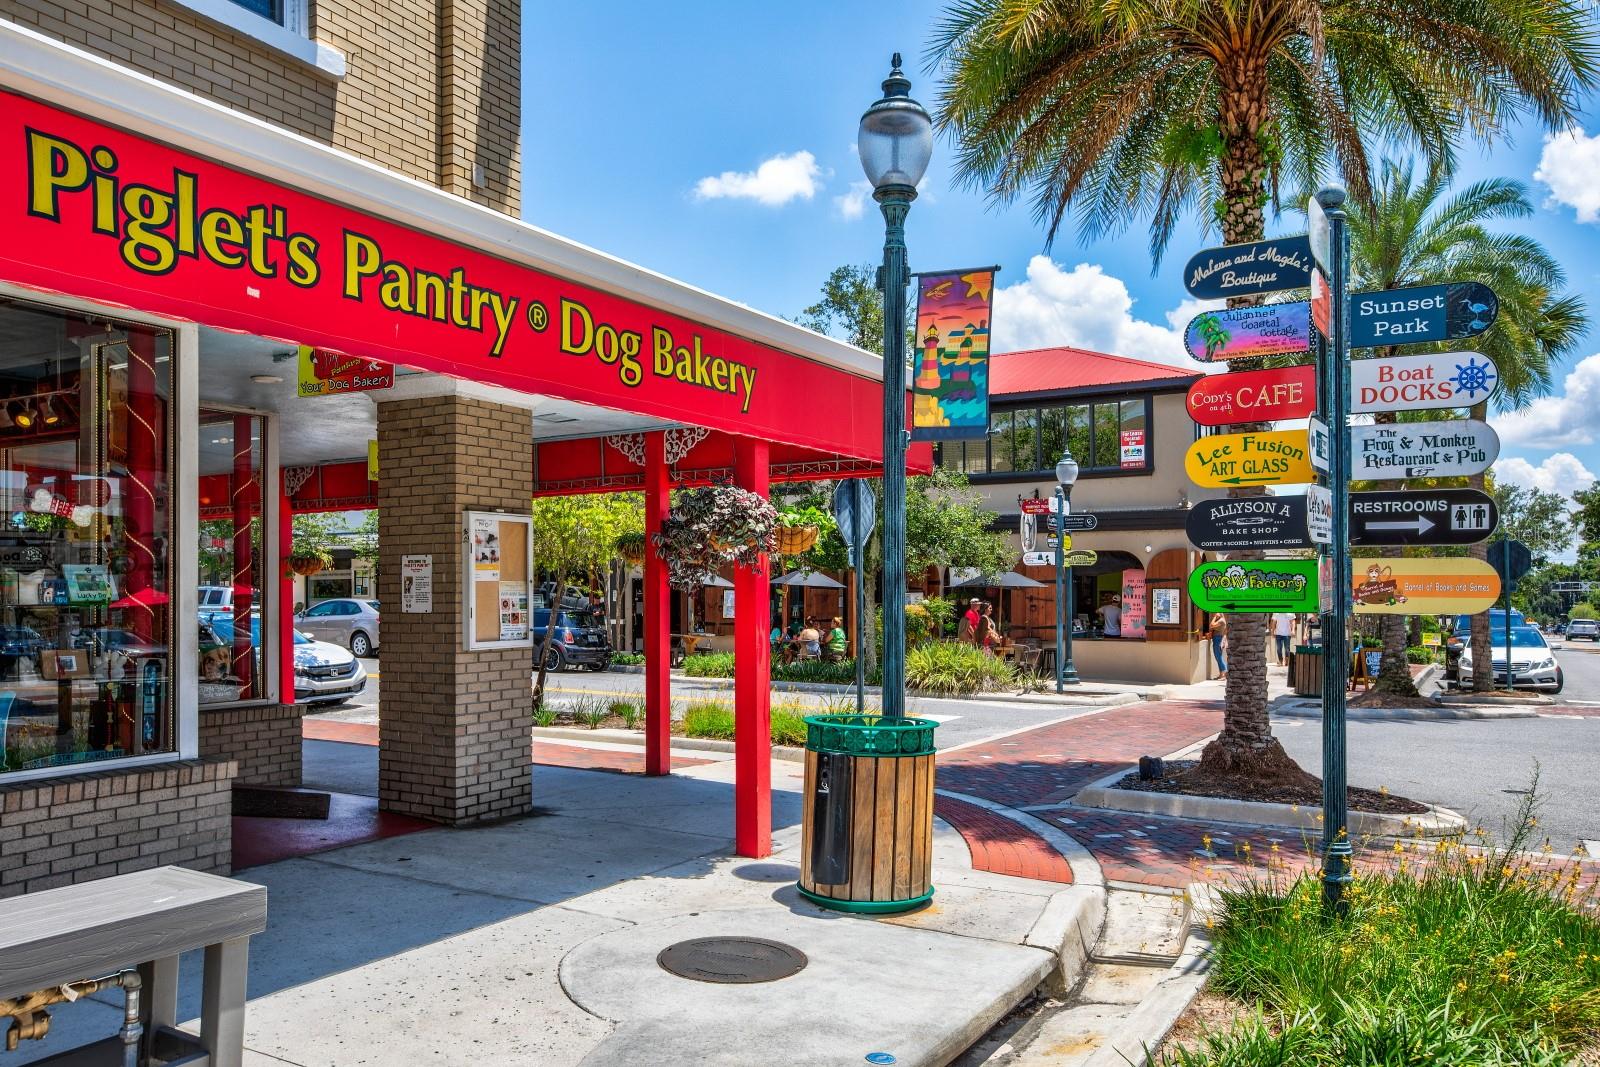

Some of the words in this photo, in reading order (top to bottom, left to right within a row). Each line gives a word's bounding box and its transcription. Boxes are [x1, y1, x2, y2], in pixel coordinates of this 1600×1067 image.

[1234, 246, 1257, 265] and
[1258, 246, 1310, 273] Magda's
[24, 125, 321, 289] Piglet's
[342, 227, 519, 358] Pantry
[559, 295, 643, 388] Dog
[652, 324, 757, 414] Bakery
[1220, 271, 1278, 288] Boutique
[1360, 295, 1445, 316] Sunset
[1241, 317, 1280, 330] Coastal
[1260, 324, 1299, 337] Cottage
[1373, 318, 1429, 337] Park
[1377, 364, 1434, 383] Boat
[300, 381, 325, 394] Your
[353, 375, 390, 387] Bakery
[1360, 381, 1453, 405] DOCKS
[1236, 382, 1303, 408] CAFE
[1220, 403, 1232, 412] 4th
[1362, 438, 1394, 453] Frog
[1400, 436, 1414, 450] &
[1419, 433, 1477, 451] Monkey
[1376, 429, 1397, 439] The
[1196, 445, 1233, 466] Lee
[1242, 436, 1304, 460] Fusion
[1363, 450, 1440, 469] Restaurant
[1443, 453, 1454, 463] &
[1456, 448, 1486, 465] Pub
[1210, 461, 1237, 477] ART
[1242, 457, 1289, 474] GLASS
[1210, 501, 1278, 520] ALLYSON
[1278, 504, 1291, 517] A
[1353, 499, 1448, 513] RESTROOMS
[1249, 574, 1303, 592] Factory
[1404, 582, 1424, 591] Barrel
[1426, 582, 1432, 591] of
[1469, 582, 1490, 592] Games
